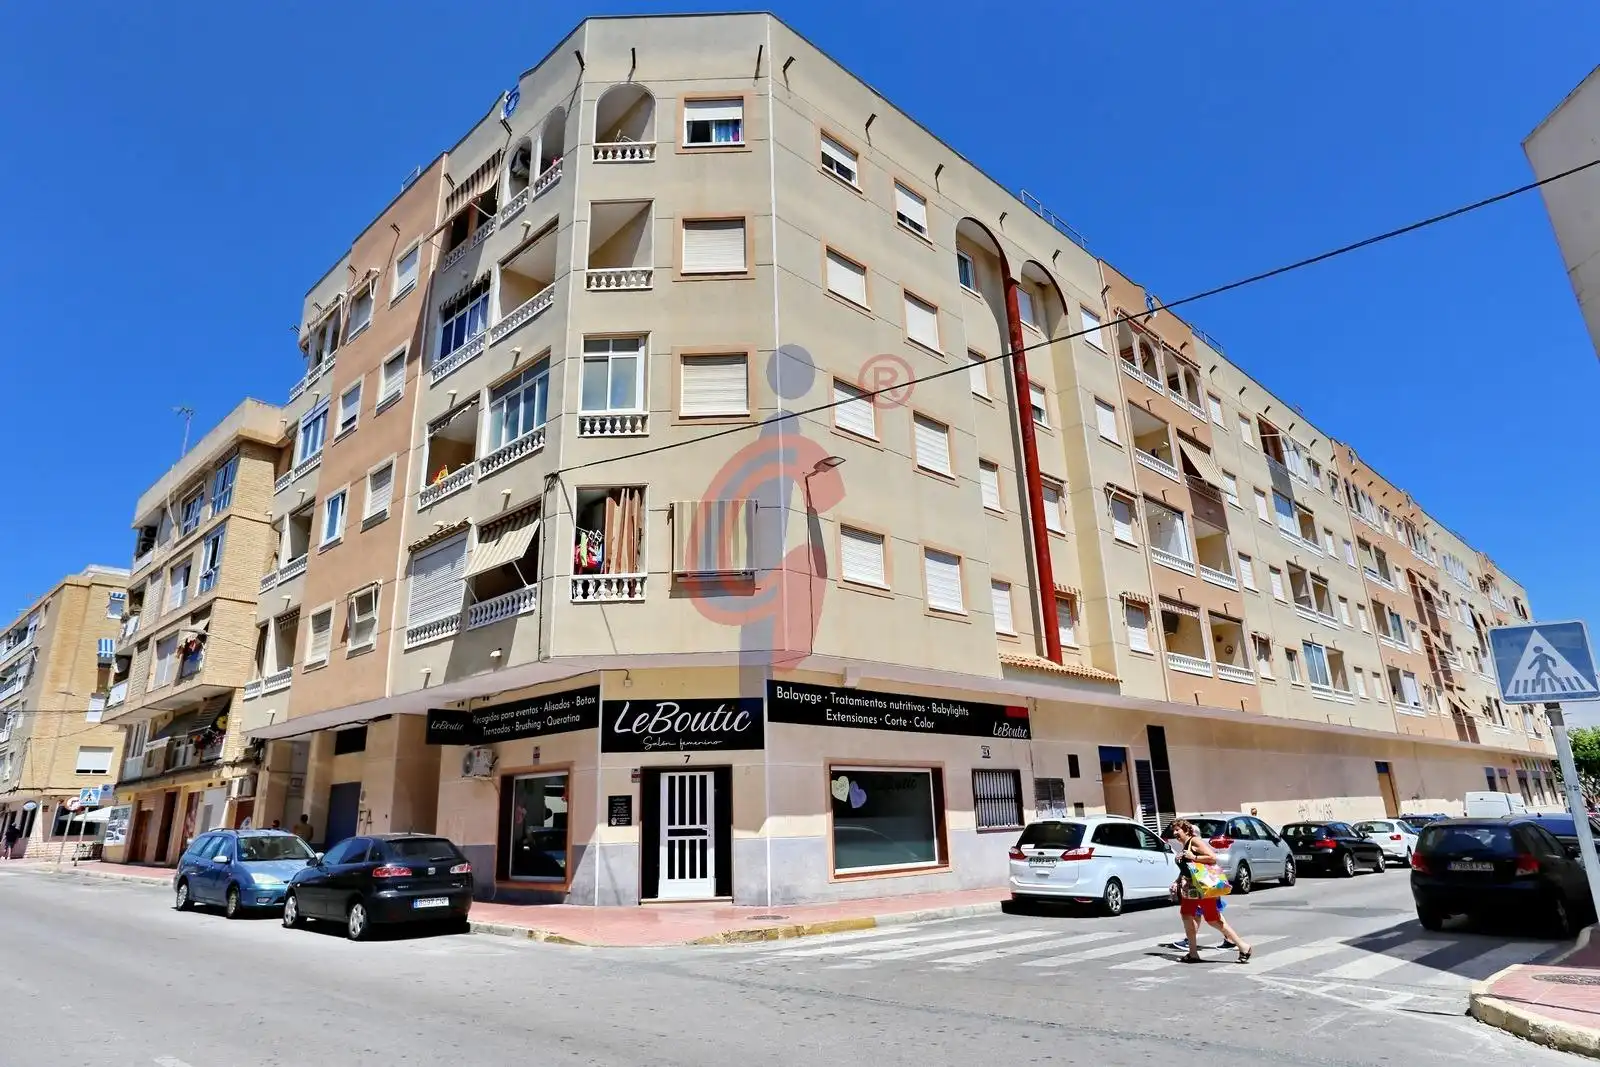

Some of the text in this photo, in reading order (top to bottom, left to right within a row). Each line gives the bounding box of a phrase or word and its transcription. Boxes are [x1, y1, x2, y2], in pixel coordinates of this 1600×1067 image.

[472, 695, 597, 725] Recogidos para eventos Alisados Botox
[776, 686, 970, 718] Balayage Tratamientos nutritivos Babylights
[482, 714, 581, 736] Trenzados Brushing Queratina
[614, 701, 752, 735] LeBoutic
[826, 709, 935, 729] Extensiones Corte Color
[679, 737, 723, 750] femenino
[683, 754, 691, 764] 7
